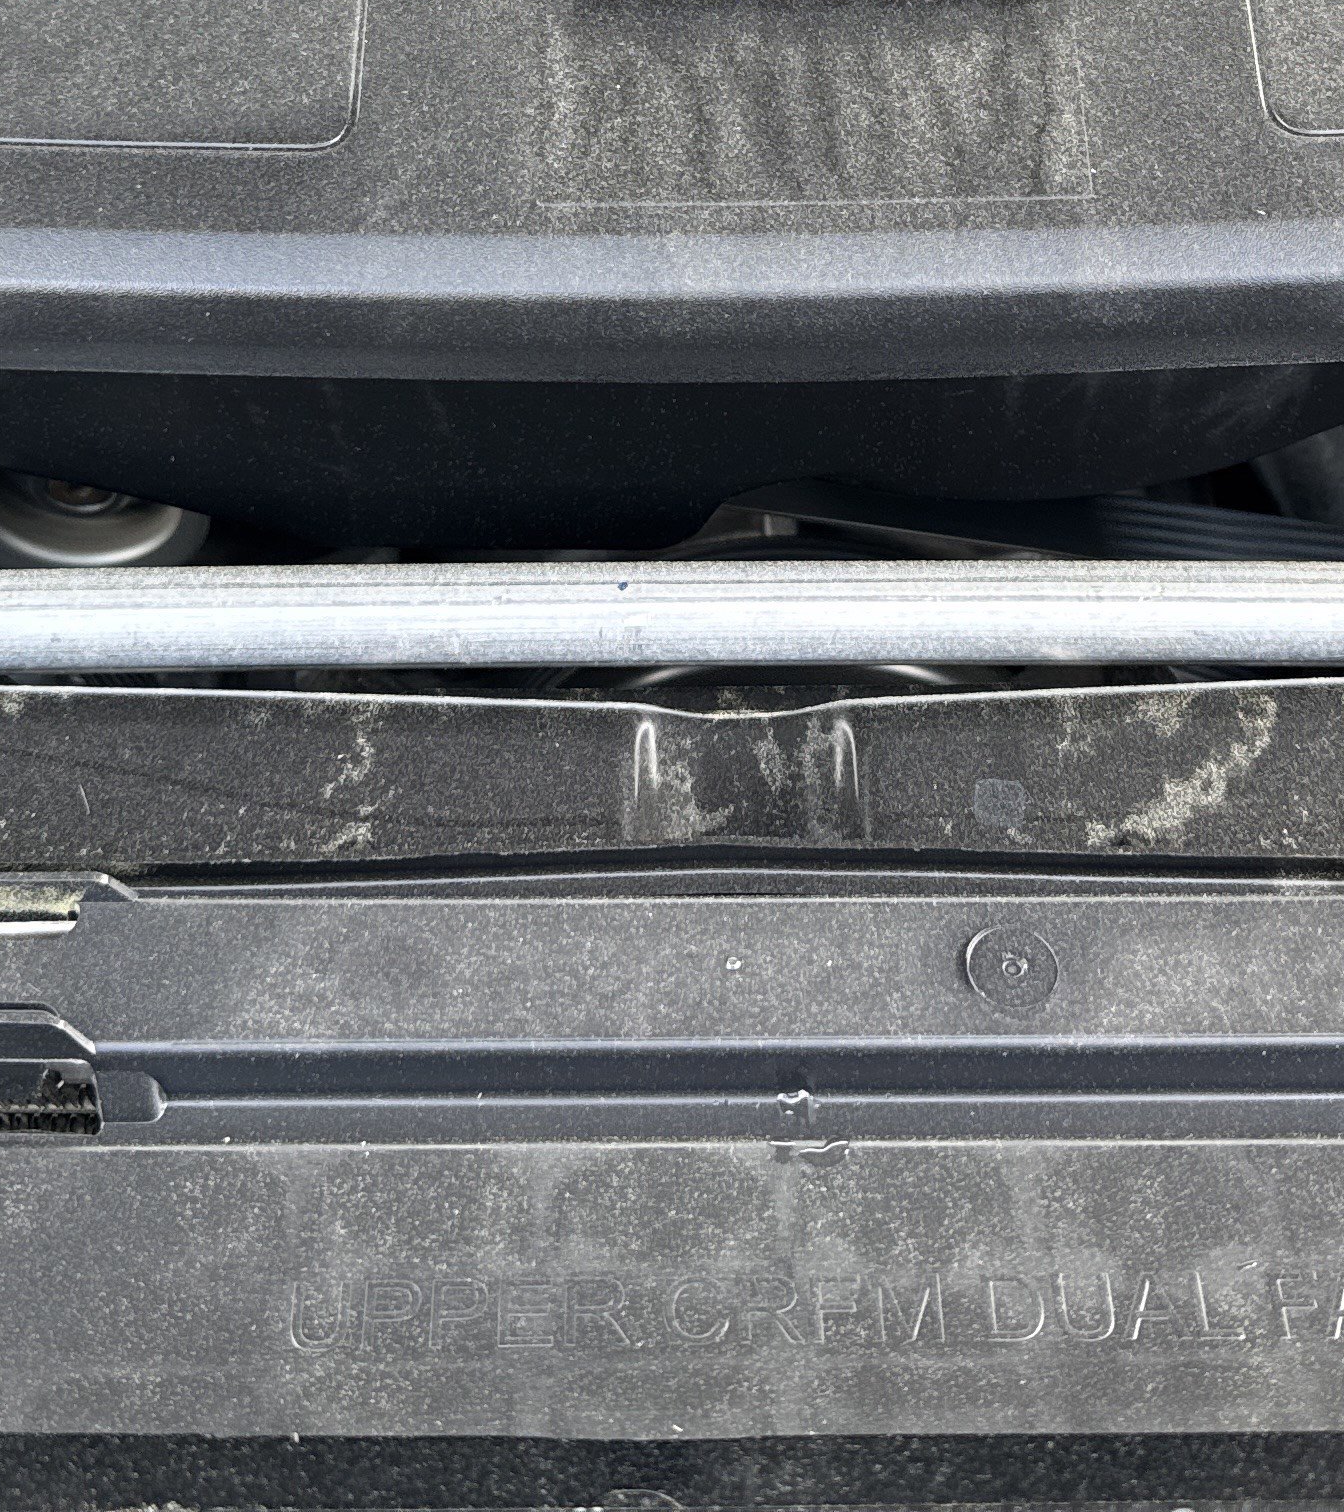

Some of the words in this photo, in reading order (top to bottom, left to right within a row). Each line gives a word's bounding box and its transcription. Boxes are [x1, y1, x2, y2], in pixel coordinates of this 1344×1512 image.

[289, 1278, 633, 1352] UPPER
[662, 1272, 947, 1346] CRFM
[981, 1270, 1246, 1342] DUAL
